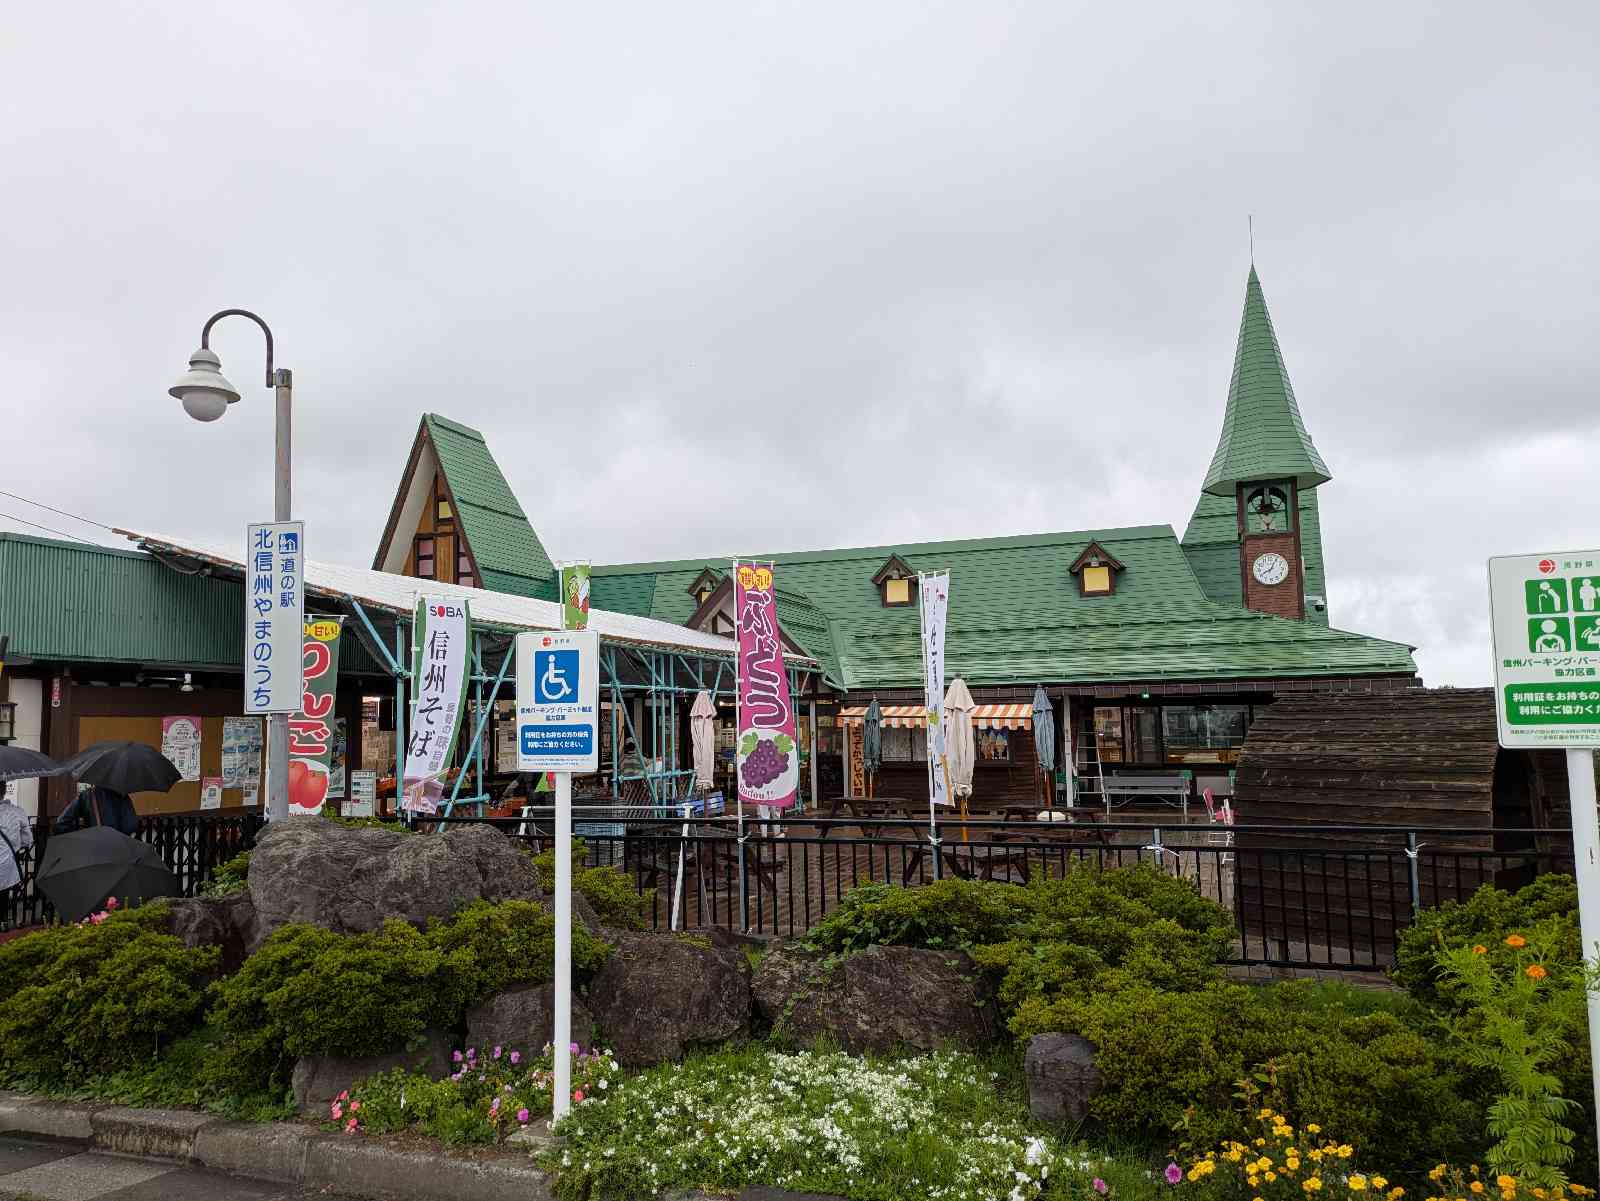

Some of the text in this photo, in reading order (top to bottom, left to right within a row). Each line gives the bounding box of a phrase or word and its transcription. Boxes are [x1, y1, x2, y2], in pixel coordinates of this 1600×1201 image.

[279, 558, 296, 608] 道の駅
[253, 528, 274, 707] 北信州やまのうち
[429, 605, 464, 619] SOBA
[1503, 656, 1600, 668] 信州パーキング・パー
[408, 630, 450, 757] 信州そば
